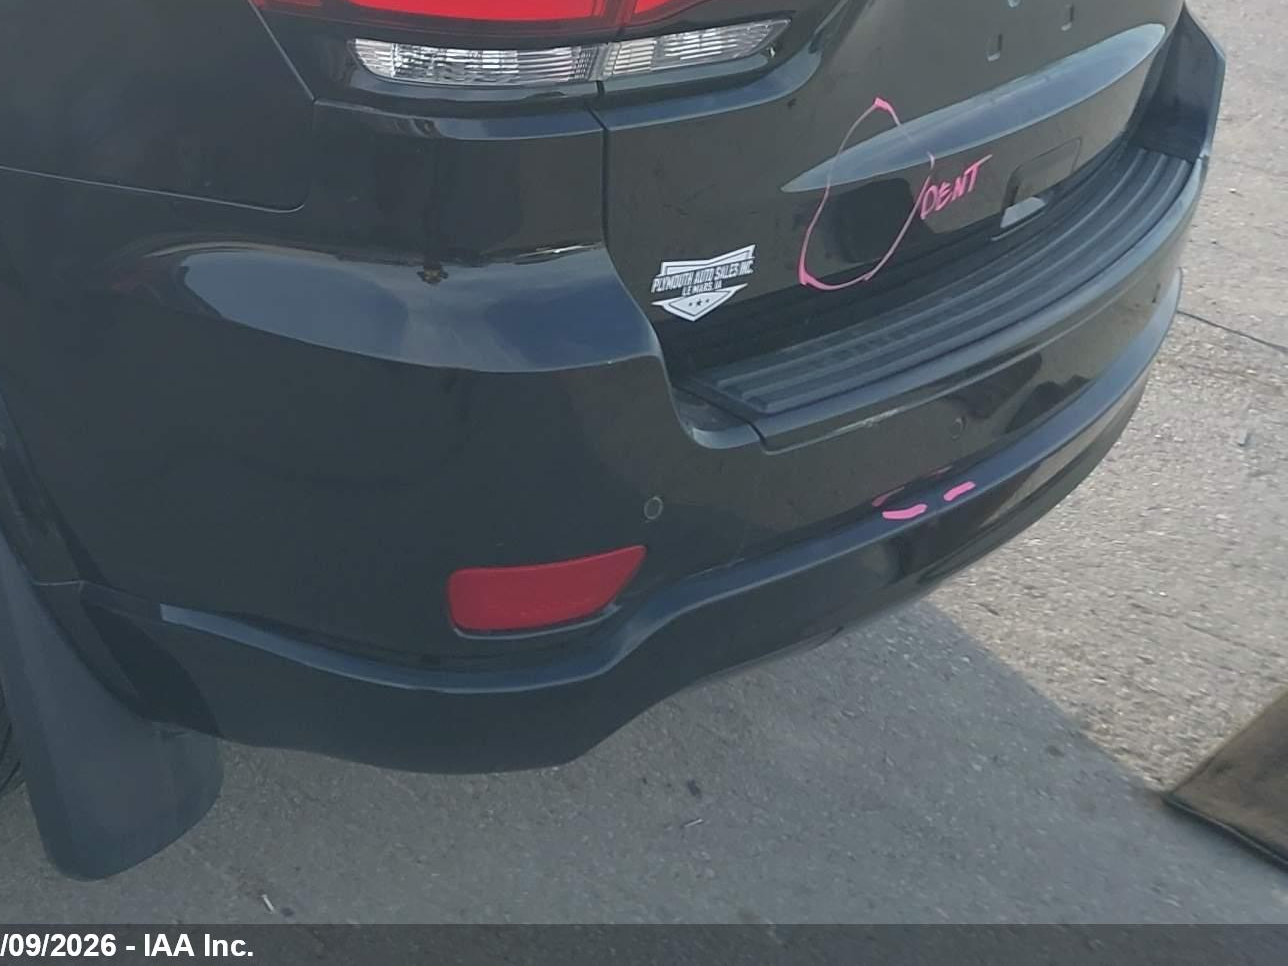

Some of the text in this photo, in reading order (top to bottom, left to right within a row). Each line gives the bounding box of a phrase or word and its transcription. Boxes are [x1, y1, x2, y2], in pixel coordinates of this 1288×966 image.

[920, 154, 992, 220] DENT
[651, 271, 694, 293] PLYMOUTH
[693, 266, 715, 284] AUTO
[713, 262, 740, 281] SALES
